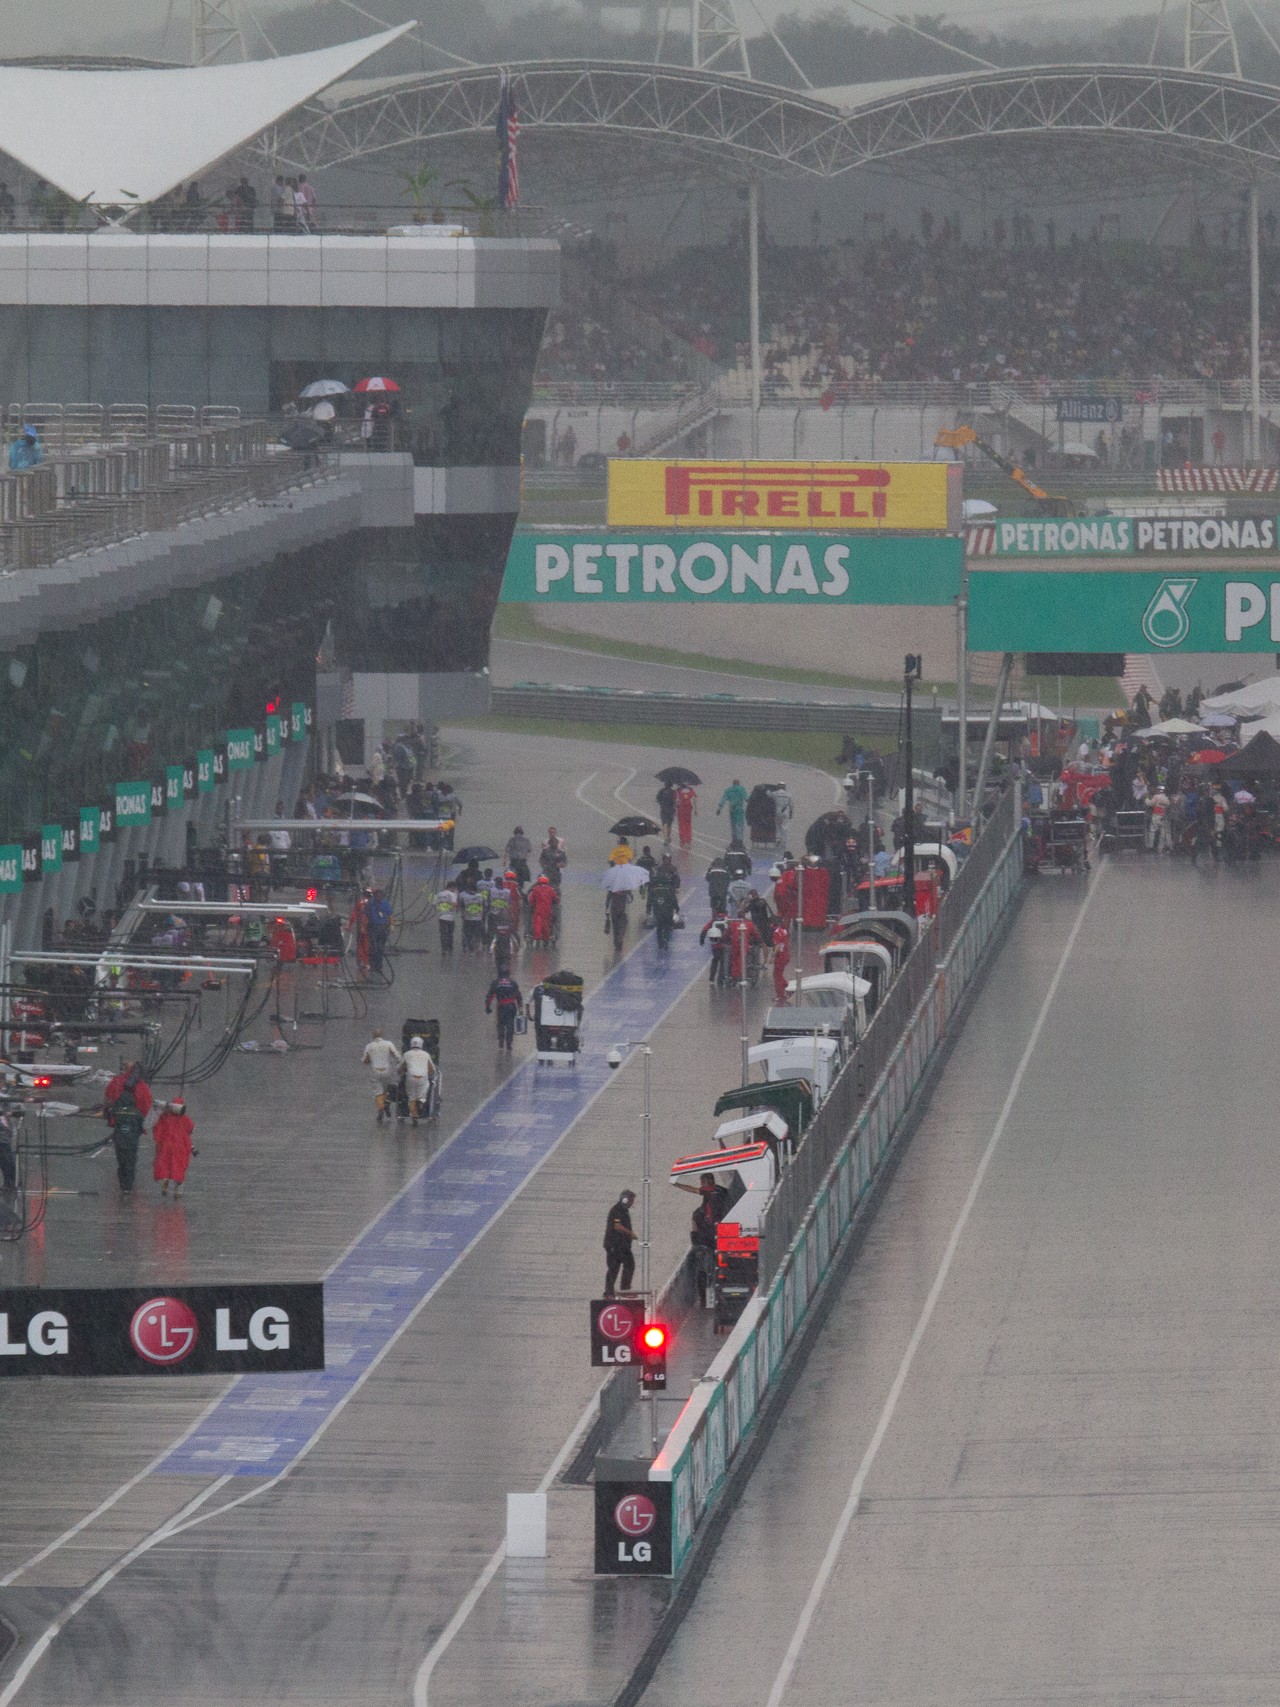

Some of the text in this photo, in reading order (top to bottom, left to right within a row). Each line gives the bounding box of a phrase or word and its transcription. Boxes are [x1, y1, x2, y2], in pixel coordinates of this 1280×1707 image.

[665, 466, 890, 518] PIRELLI
[1001, 521, 1131, 551] PETRONAS
[1138, 520, 1273, 550] PETRONAS
[534, 542, 851, 597] PETRONAS
[0, 1311, 69, 1356] LG
[216, 1307, 290, 1351] LG
[602, 1345, 632, 1363] LG
[617, 1541, 652, 1563] LG
